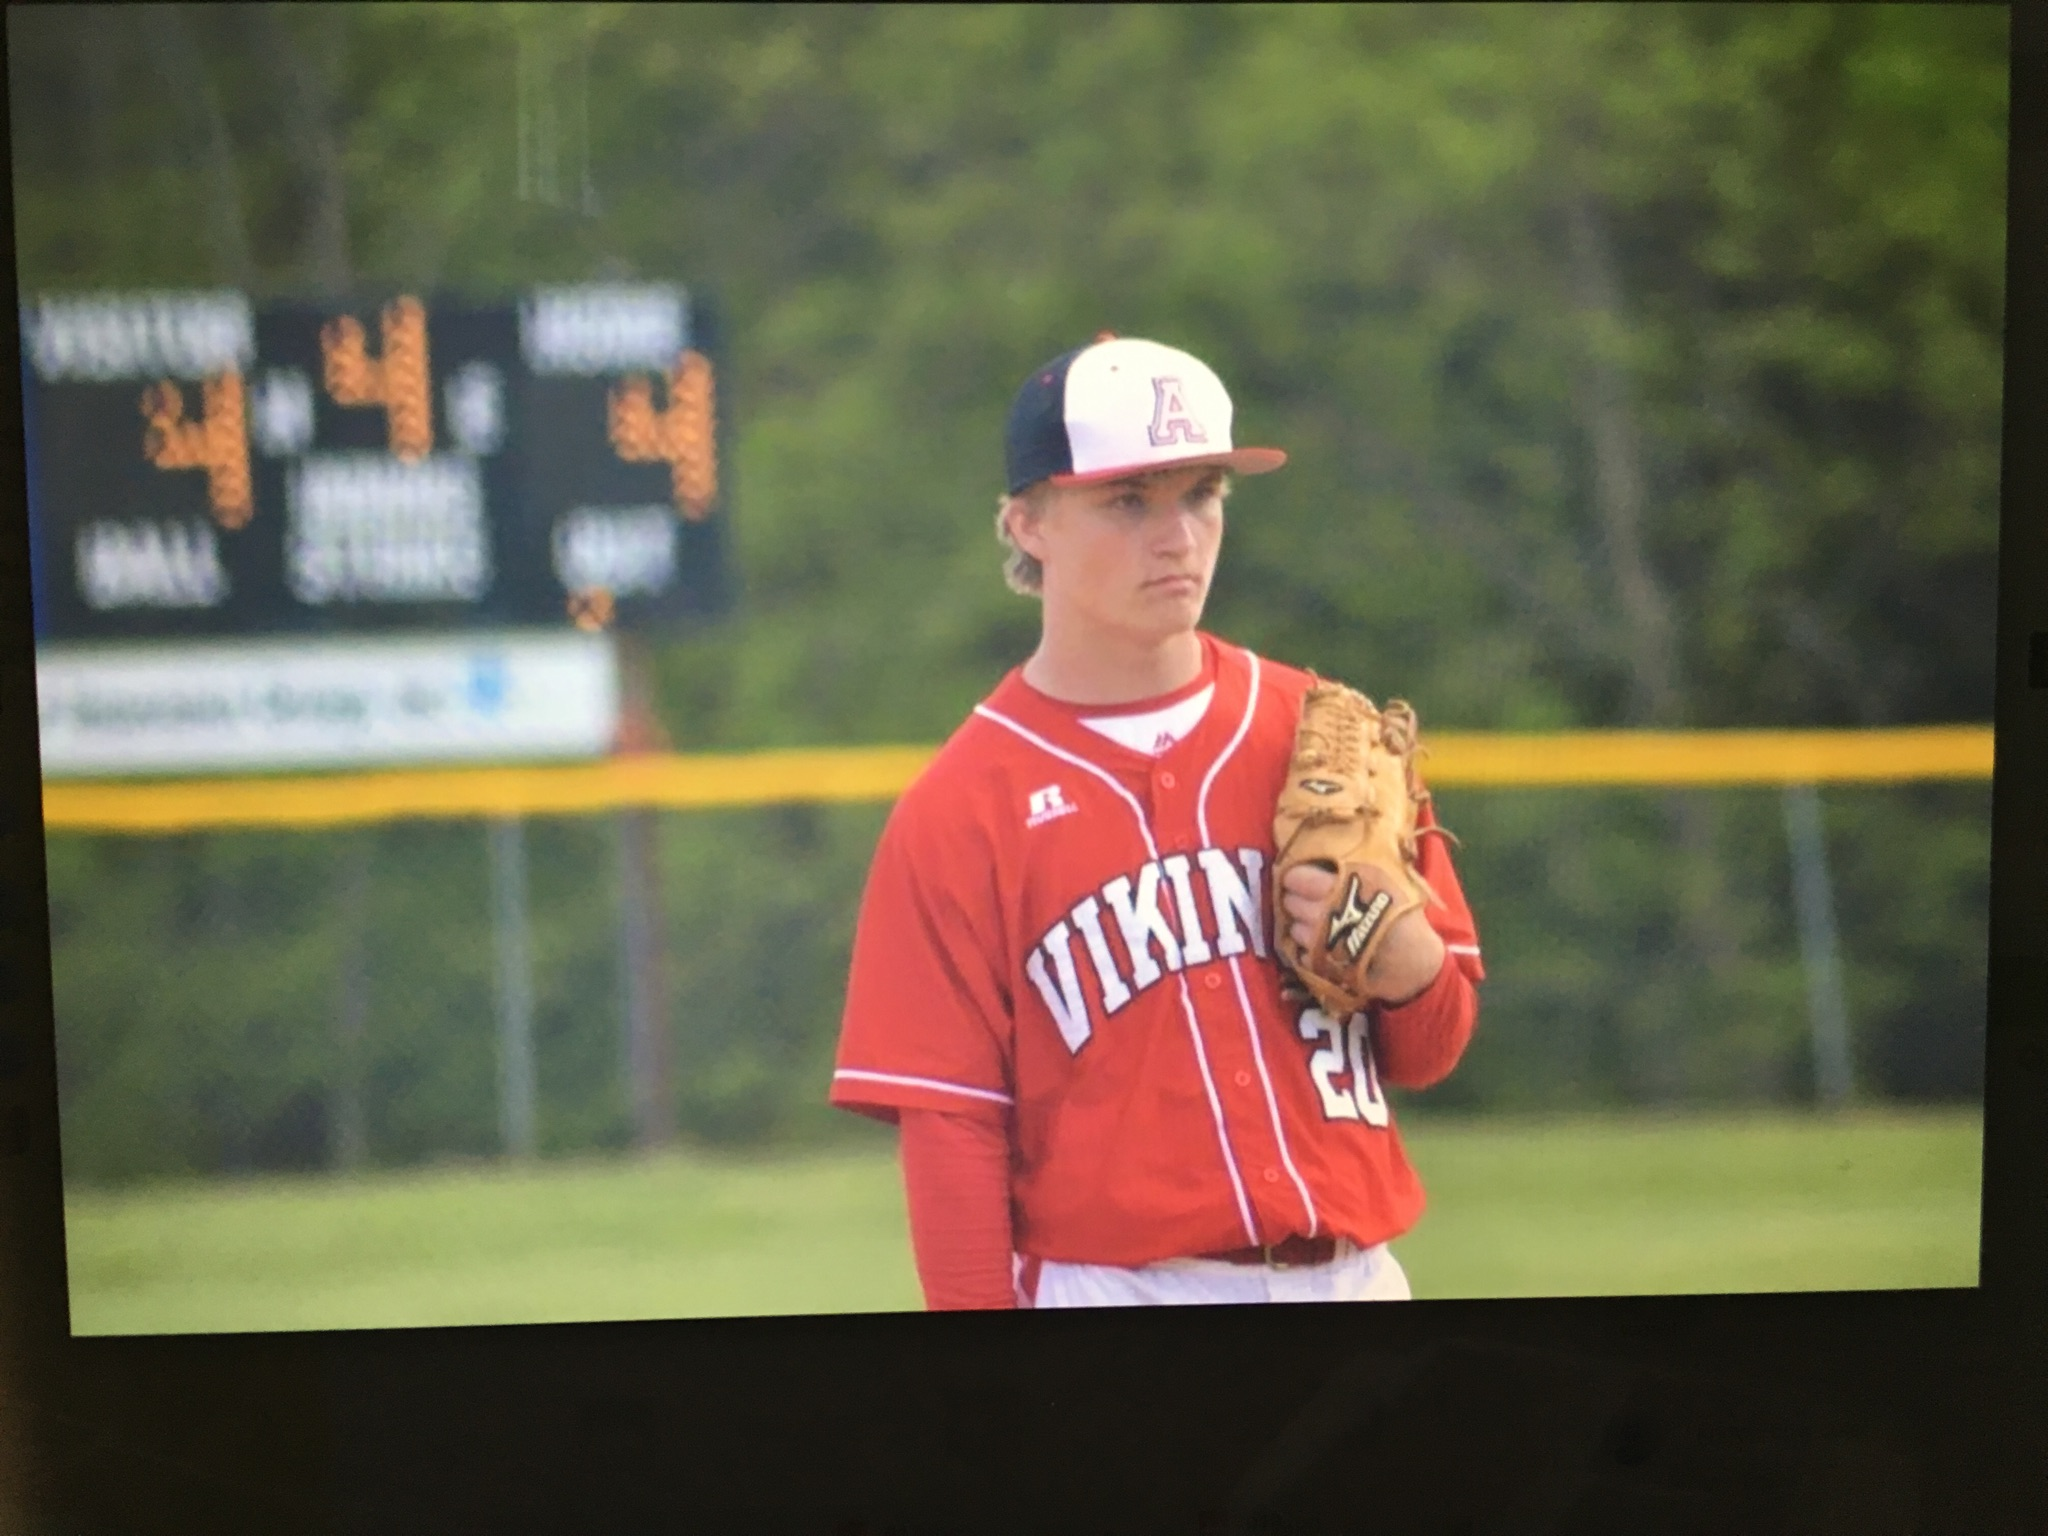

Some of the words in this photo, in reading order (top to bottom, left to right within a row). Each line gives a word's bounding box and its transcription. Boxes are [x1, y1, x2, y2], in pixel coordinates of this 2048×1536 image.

[140, 367, 252, 530] 4
[321, 296, 432, 464] 4
[608, 350, 717, 521] 4
[1147, 376, 1208, 447] A
[1298, 1006, 1390, 1129] 20
